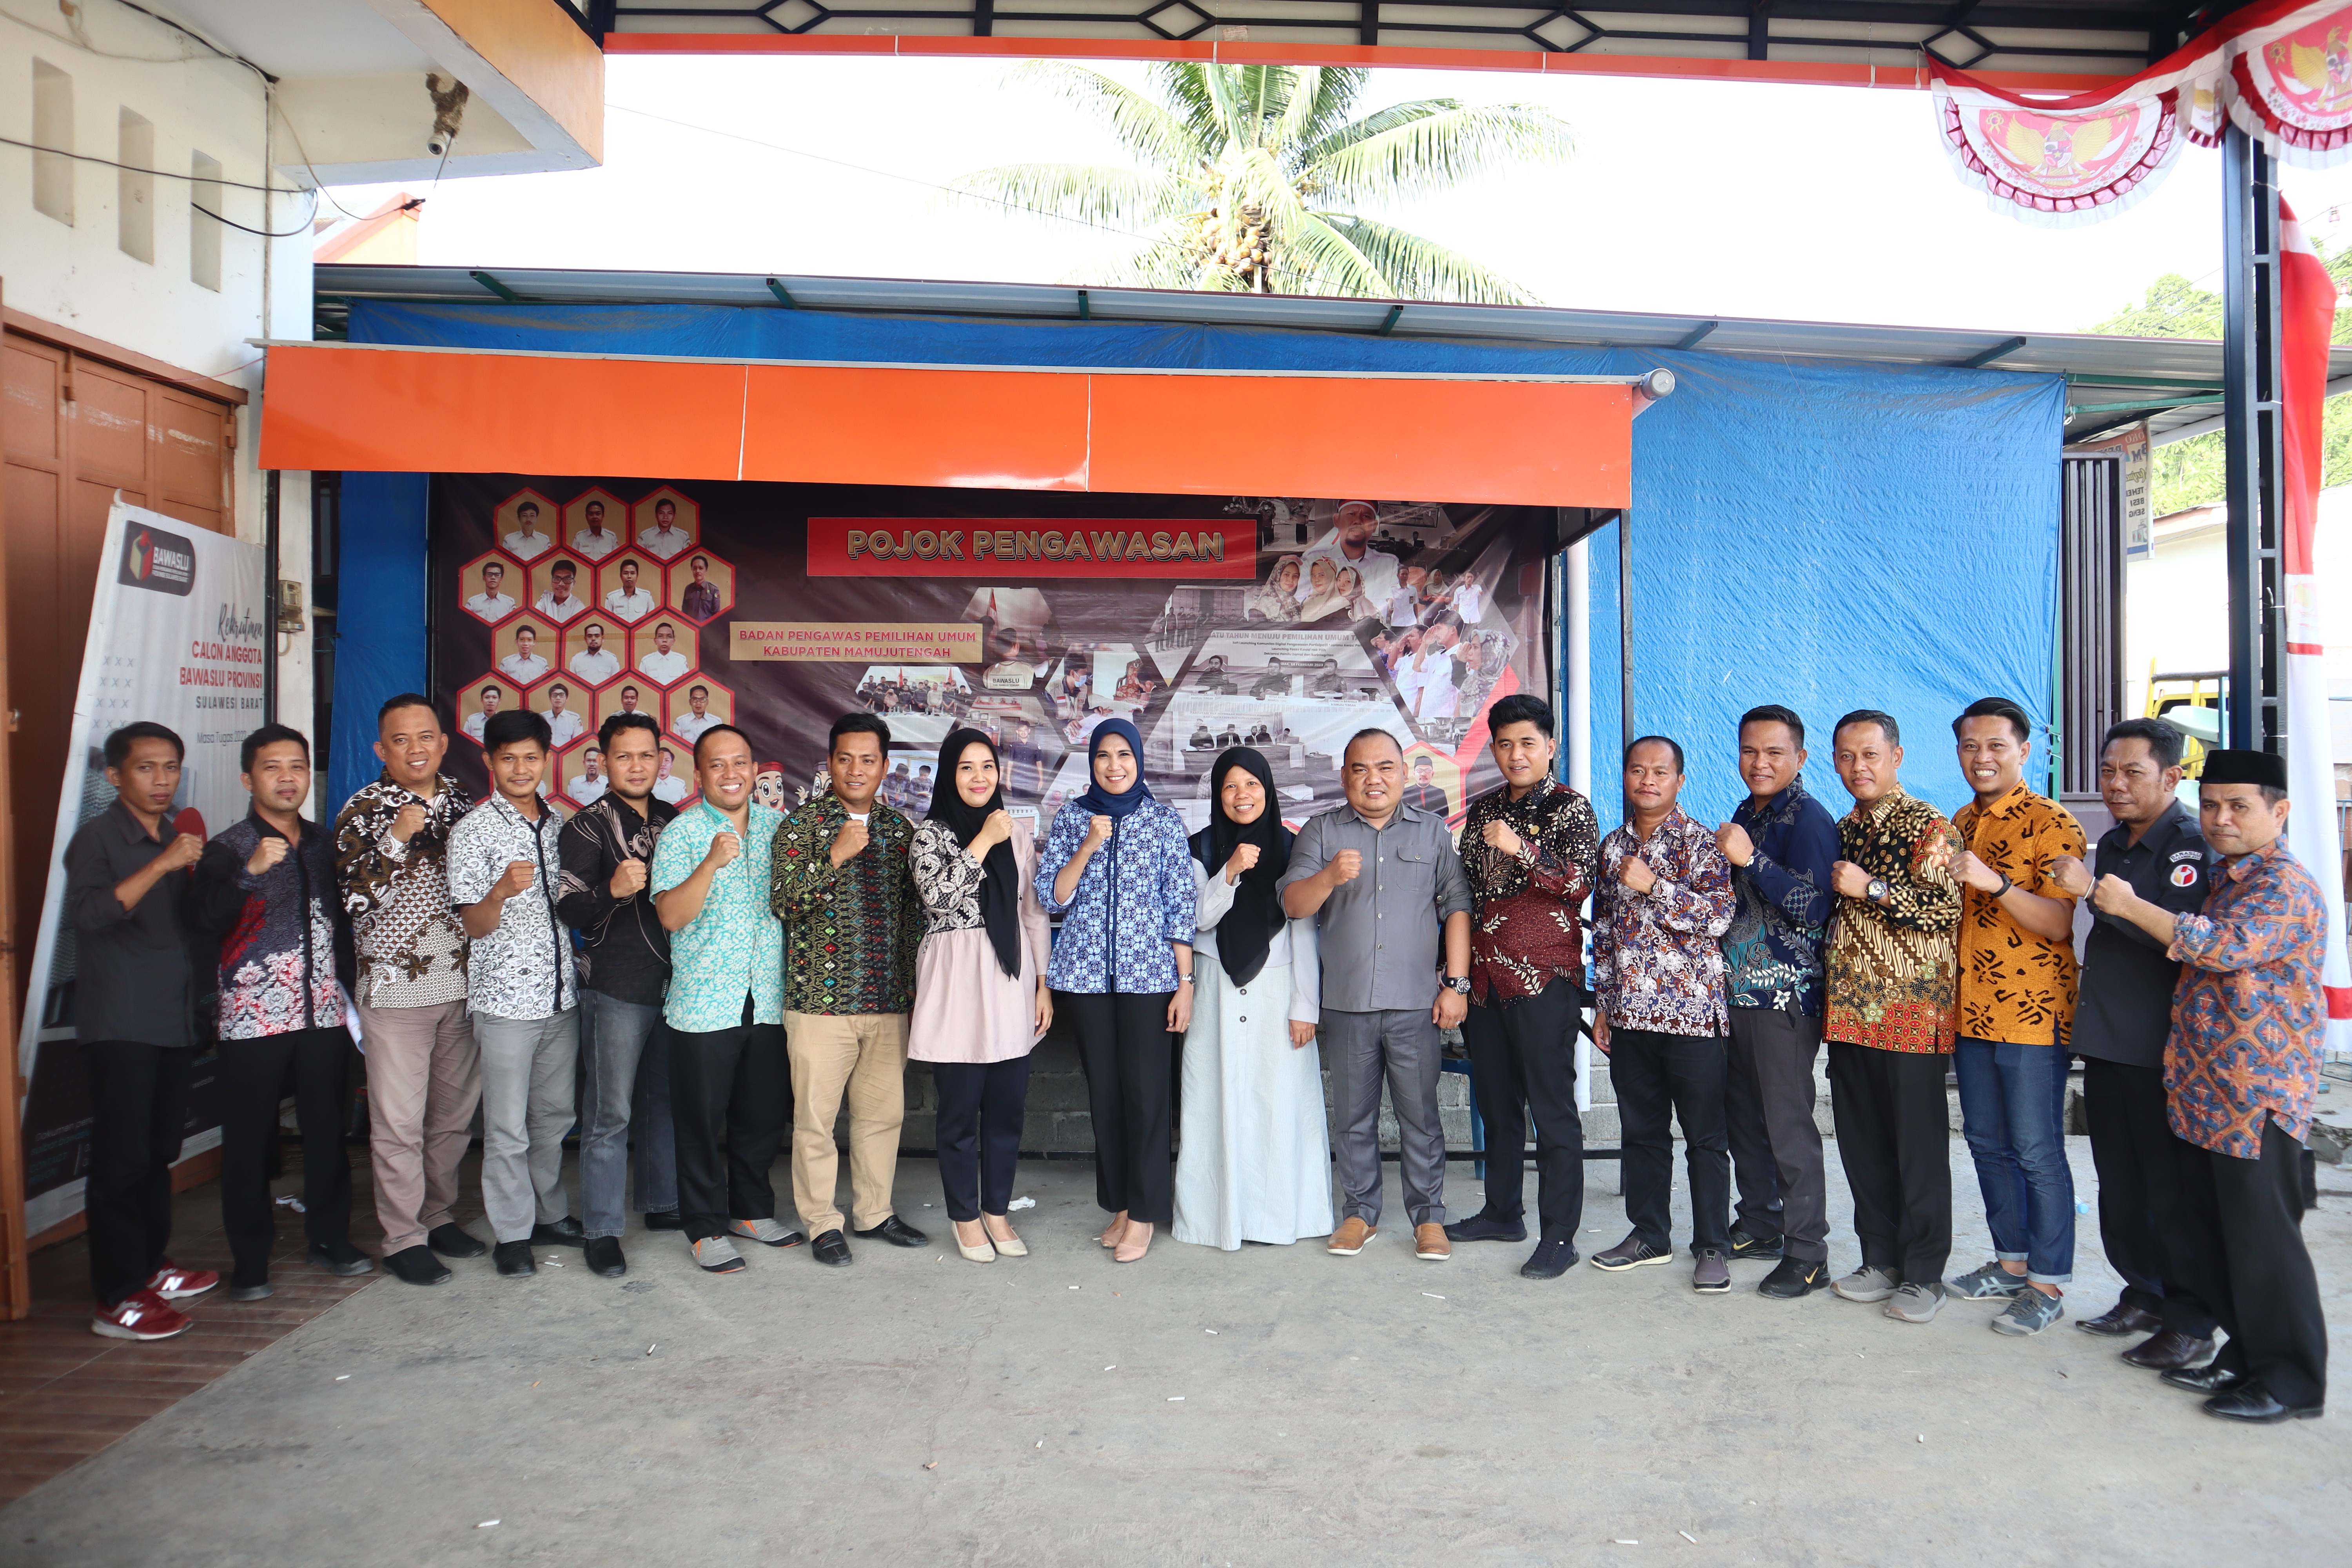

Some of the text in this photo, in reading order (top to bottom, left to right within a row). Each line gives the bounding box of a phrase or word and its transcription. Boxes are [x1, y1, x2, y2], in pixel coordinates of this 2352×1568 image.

[848, 530, 1225, 562] POJOK PENGAWASAN
[153, 546, 189, 571] BAWASLU
[218, 603, 263, 642] Rekrutmen
[739, 629, 976, 642] BADAN PENGAWAS PEMILIHAN UMUM
[192, 640, 262, 664] CALON ANGGOTA
[763, 645, 951, 657] KABUPATEN MAMUJUTENGAH
[180, 667, 262, 689] BAWASLU PROVINSI
[196, 696, 263, 710] SULAWESI BARAT
[197, 732, 214, 744] Masa
[216, 731, 233, 746] Tugas
